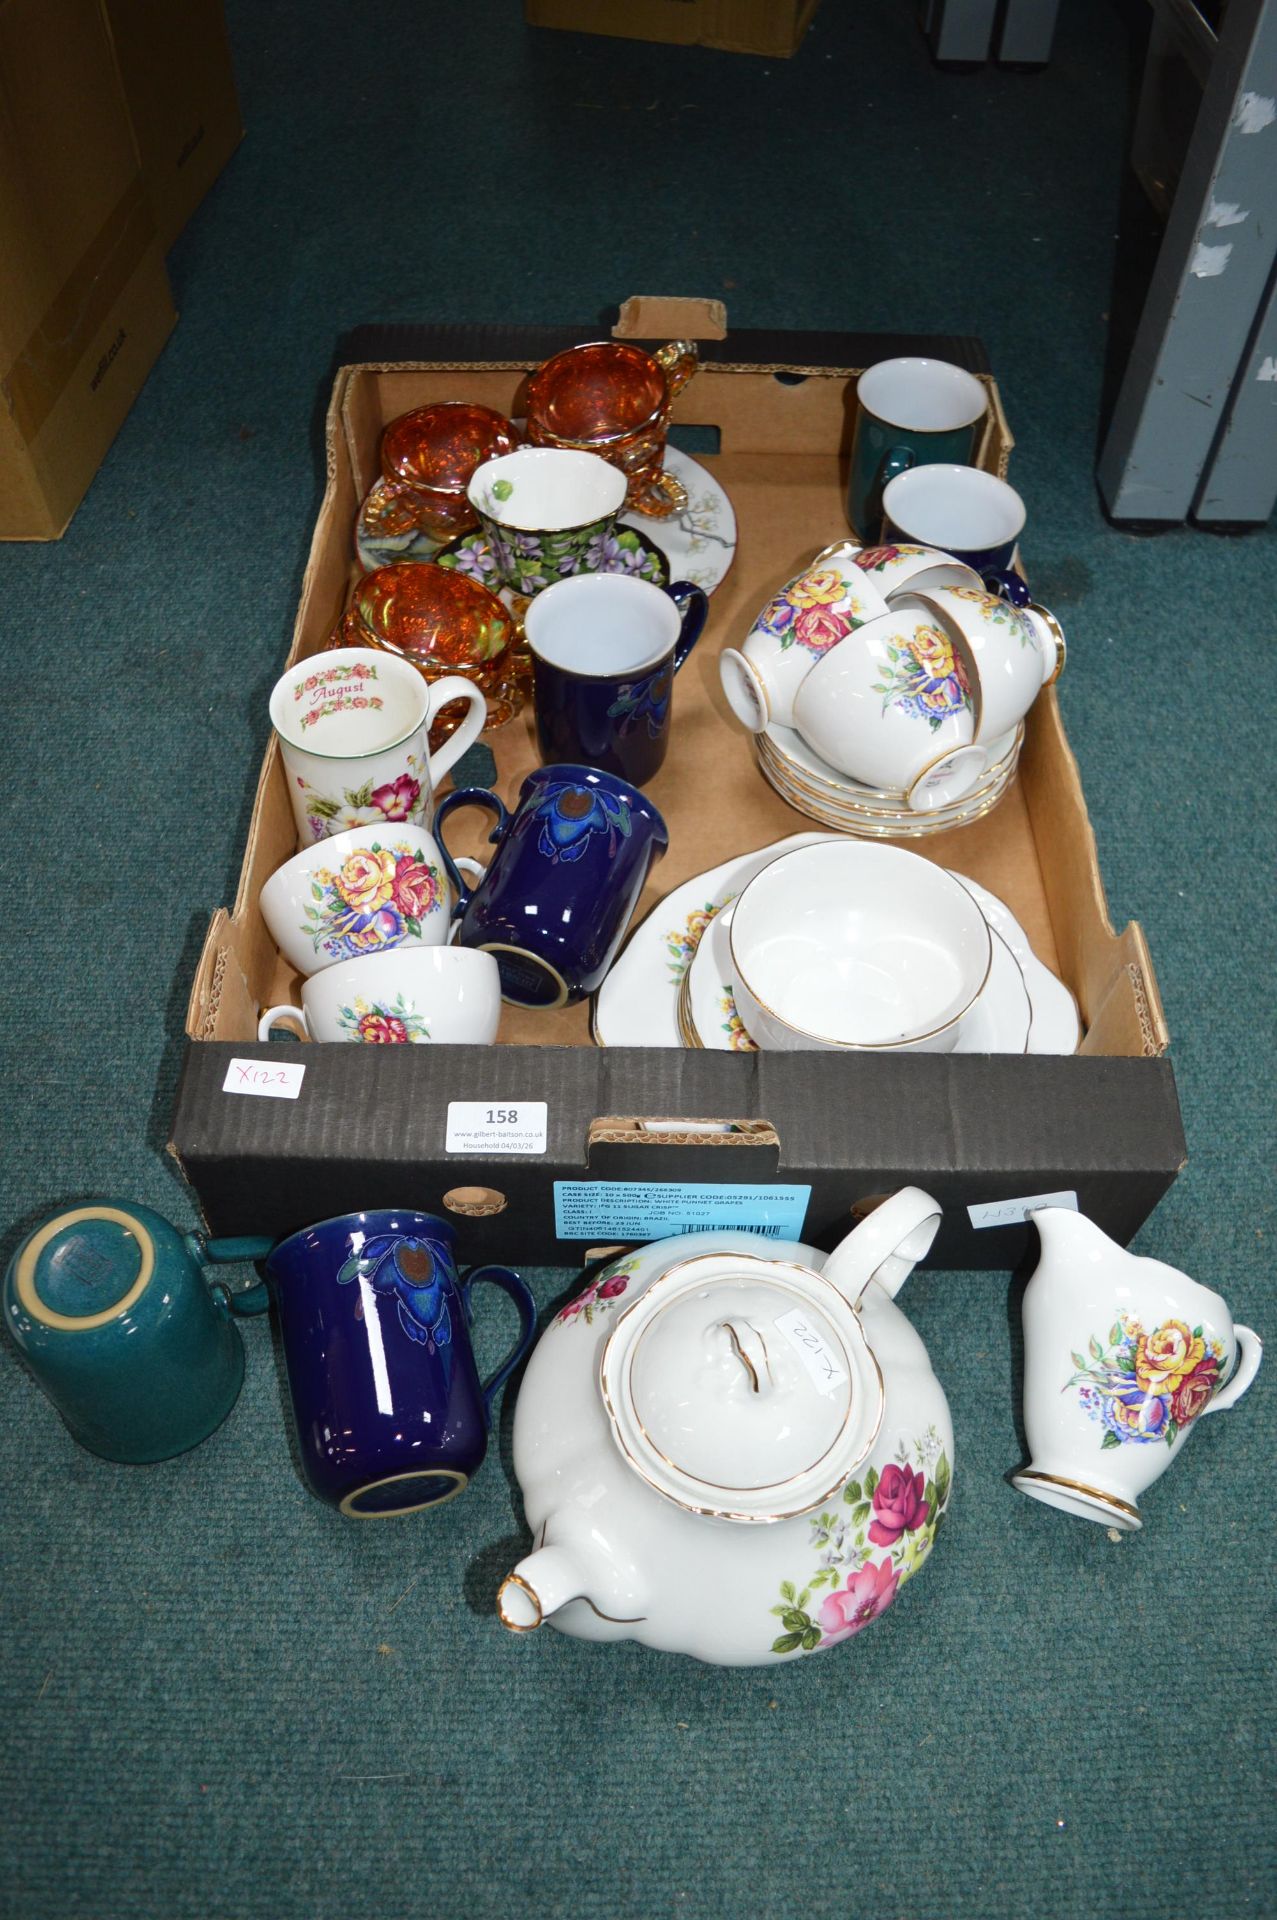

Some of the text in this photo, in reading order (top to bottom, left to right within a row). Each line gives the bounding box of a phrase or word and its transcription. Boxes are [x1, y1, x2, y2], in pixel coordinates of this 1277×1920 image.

[309, 682, 364, 706] August
[236, 1065, 289, 1084] X122
[486, 1110, 518, 1124] 158
